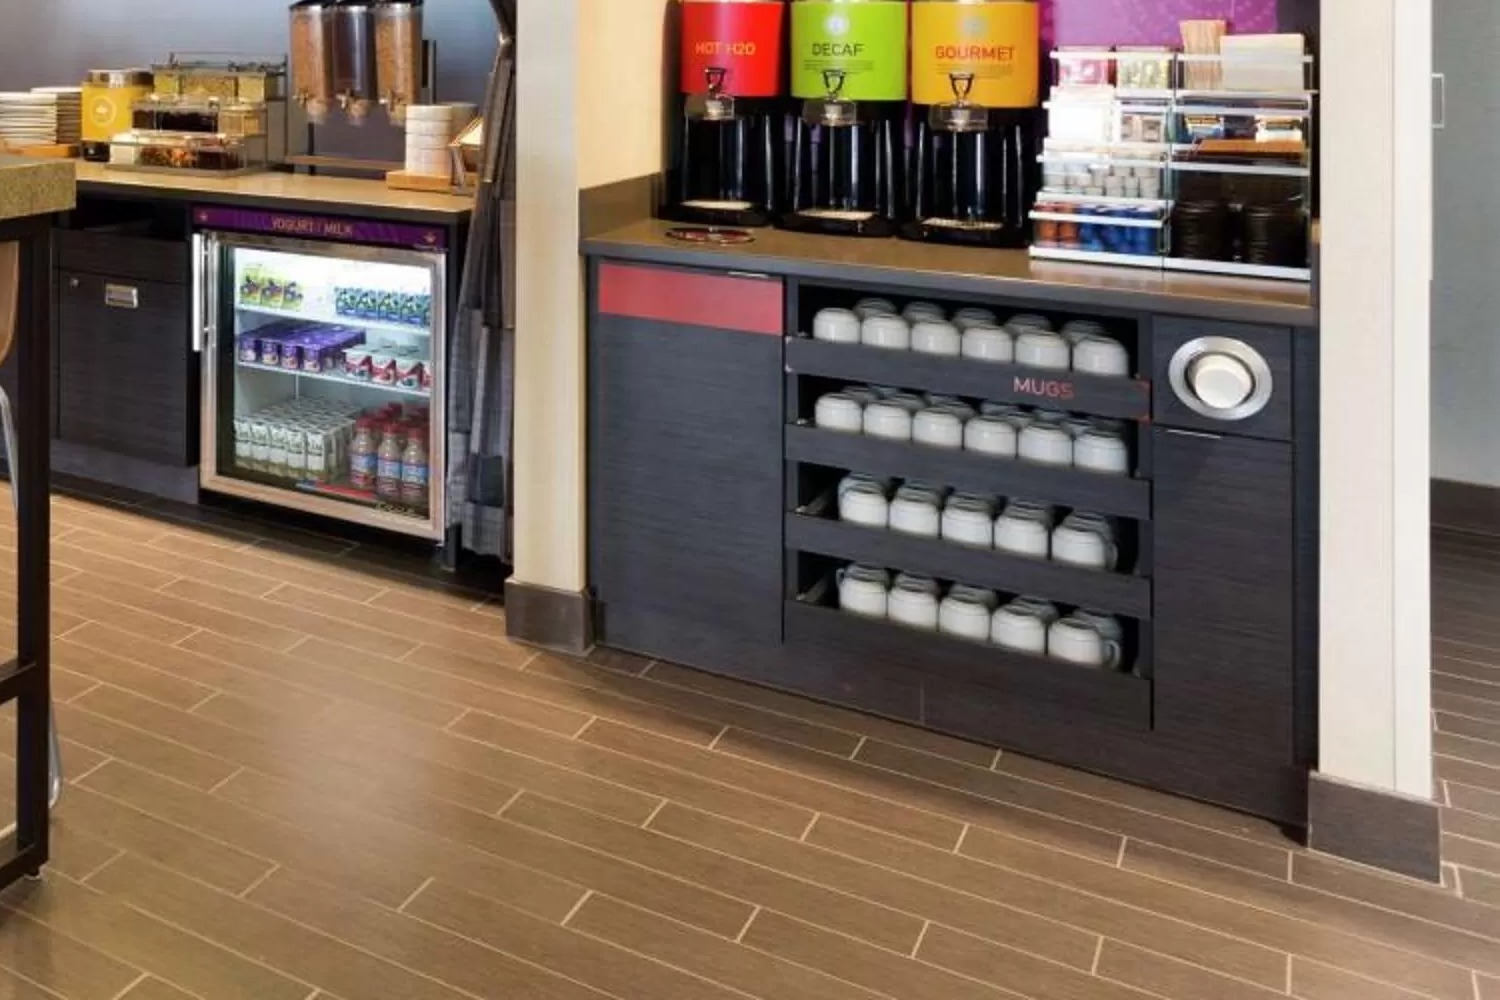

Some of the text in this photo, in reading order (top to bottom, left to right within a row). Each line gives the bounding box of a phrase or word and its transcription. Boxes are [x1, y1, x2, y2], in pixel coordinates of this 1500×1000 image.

[695, 40, 722, 55] HOT
[811, 42, 864, 57] DECAF
[935, 44, 1014, 61] GOURMET
[272, 217, 313, 232] YOGURT
[324, 221, 353, 235] MILK
[1013, 376, 1075, 399] MUGS
